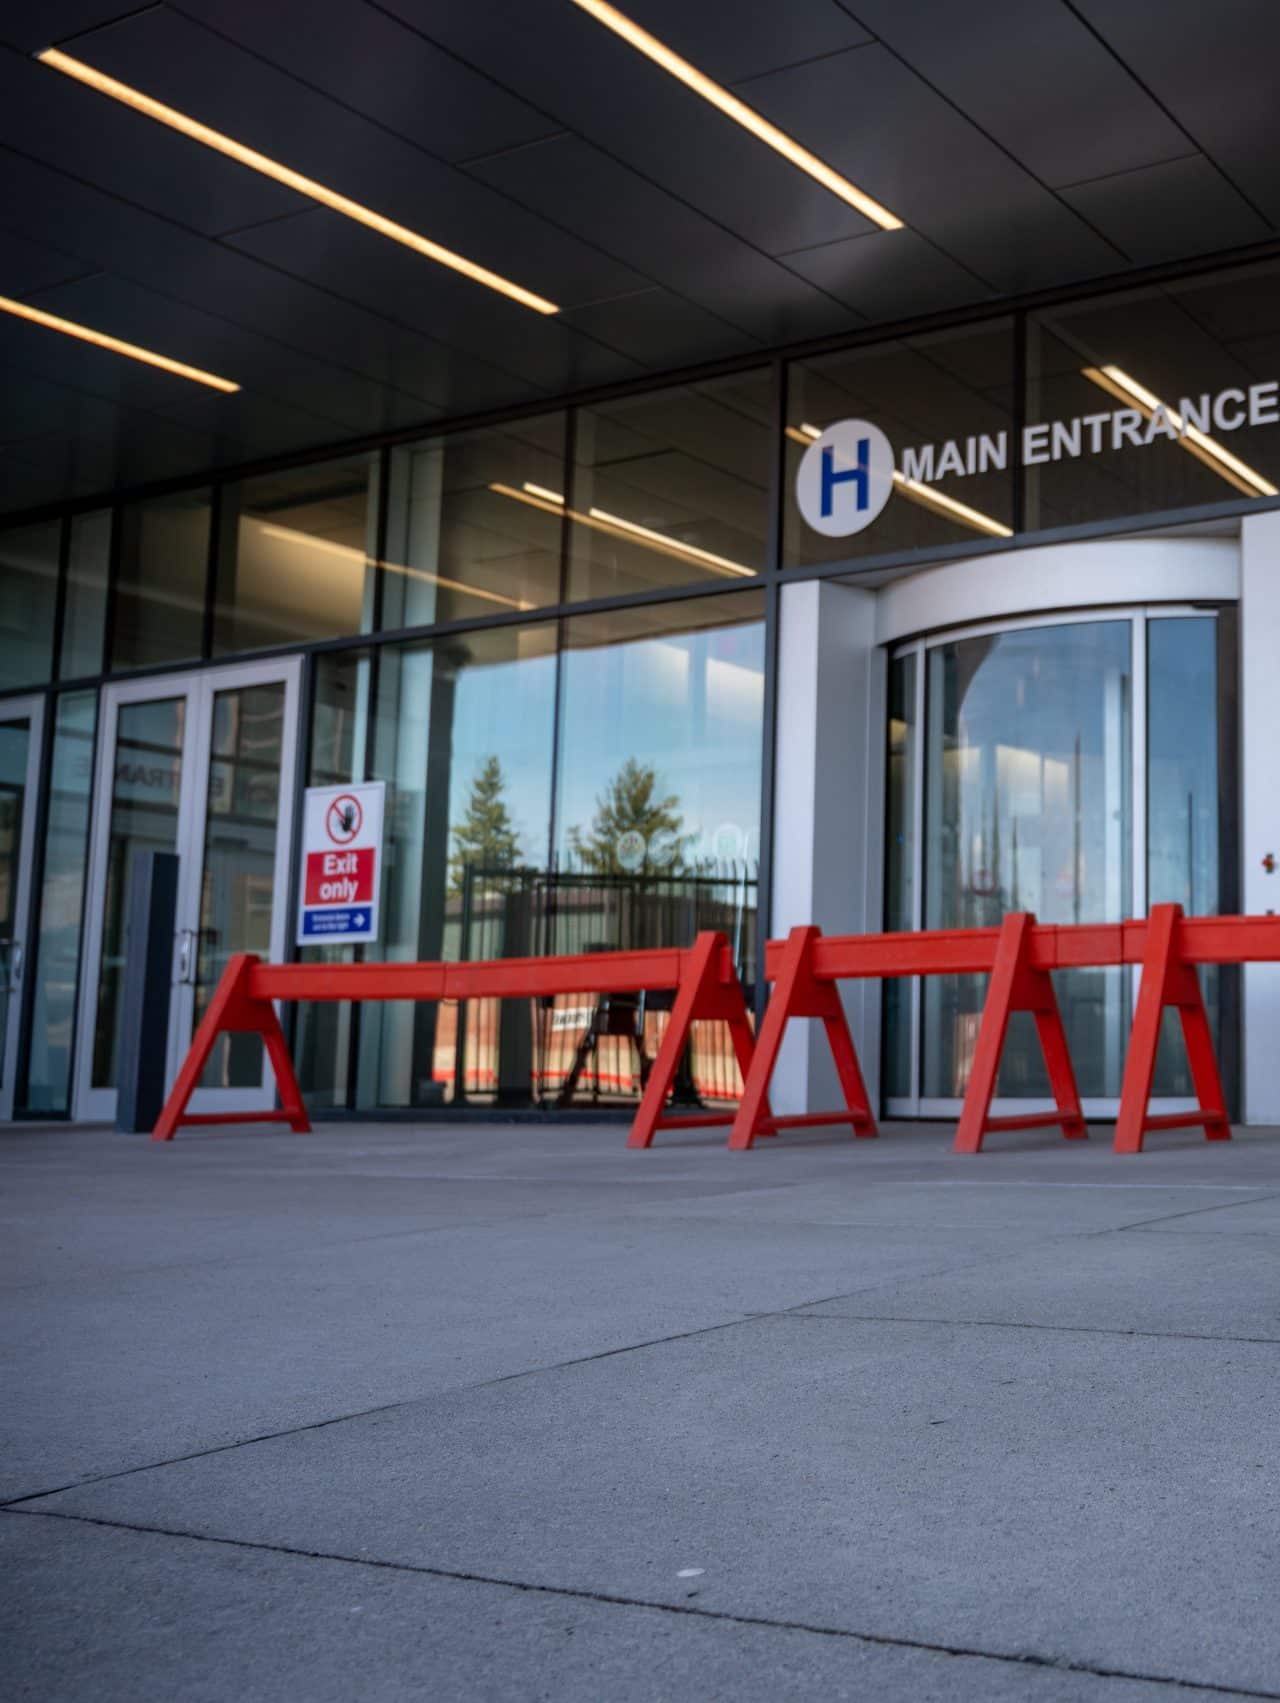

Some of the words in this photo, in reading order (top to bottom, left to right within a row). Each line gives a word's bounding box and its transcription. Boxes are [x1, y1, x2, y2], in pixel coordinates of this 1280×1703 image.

[820, 438, 871, 518] H
[902, 430, 1007, 483] MAIN
[1022, 381, 1280, 466] ENTRANCE
[322, 852, 358, 876] Exit
[319, 876, 359, 902] only
